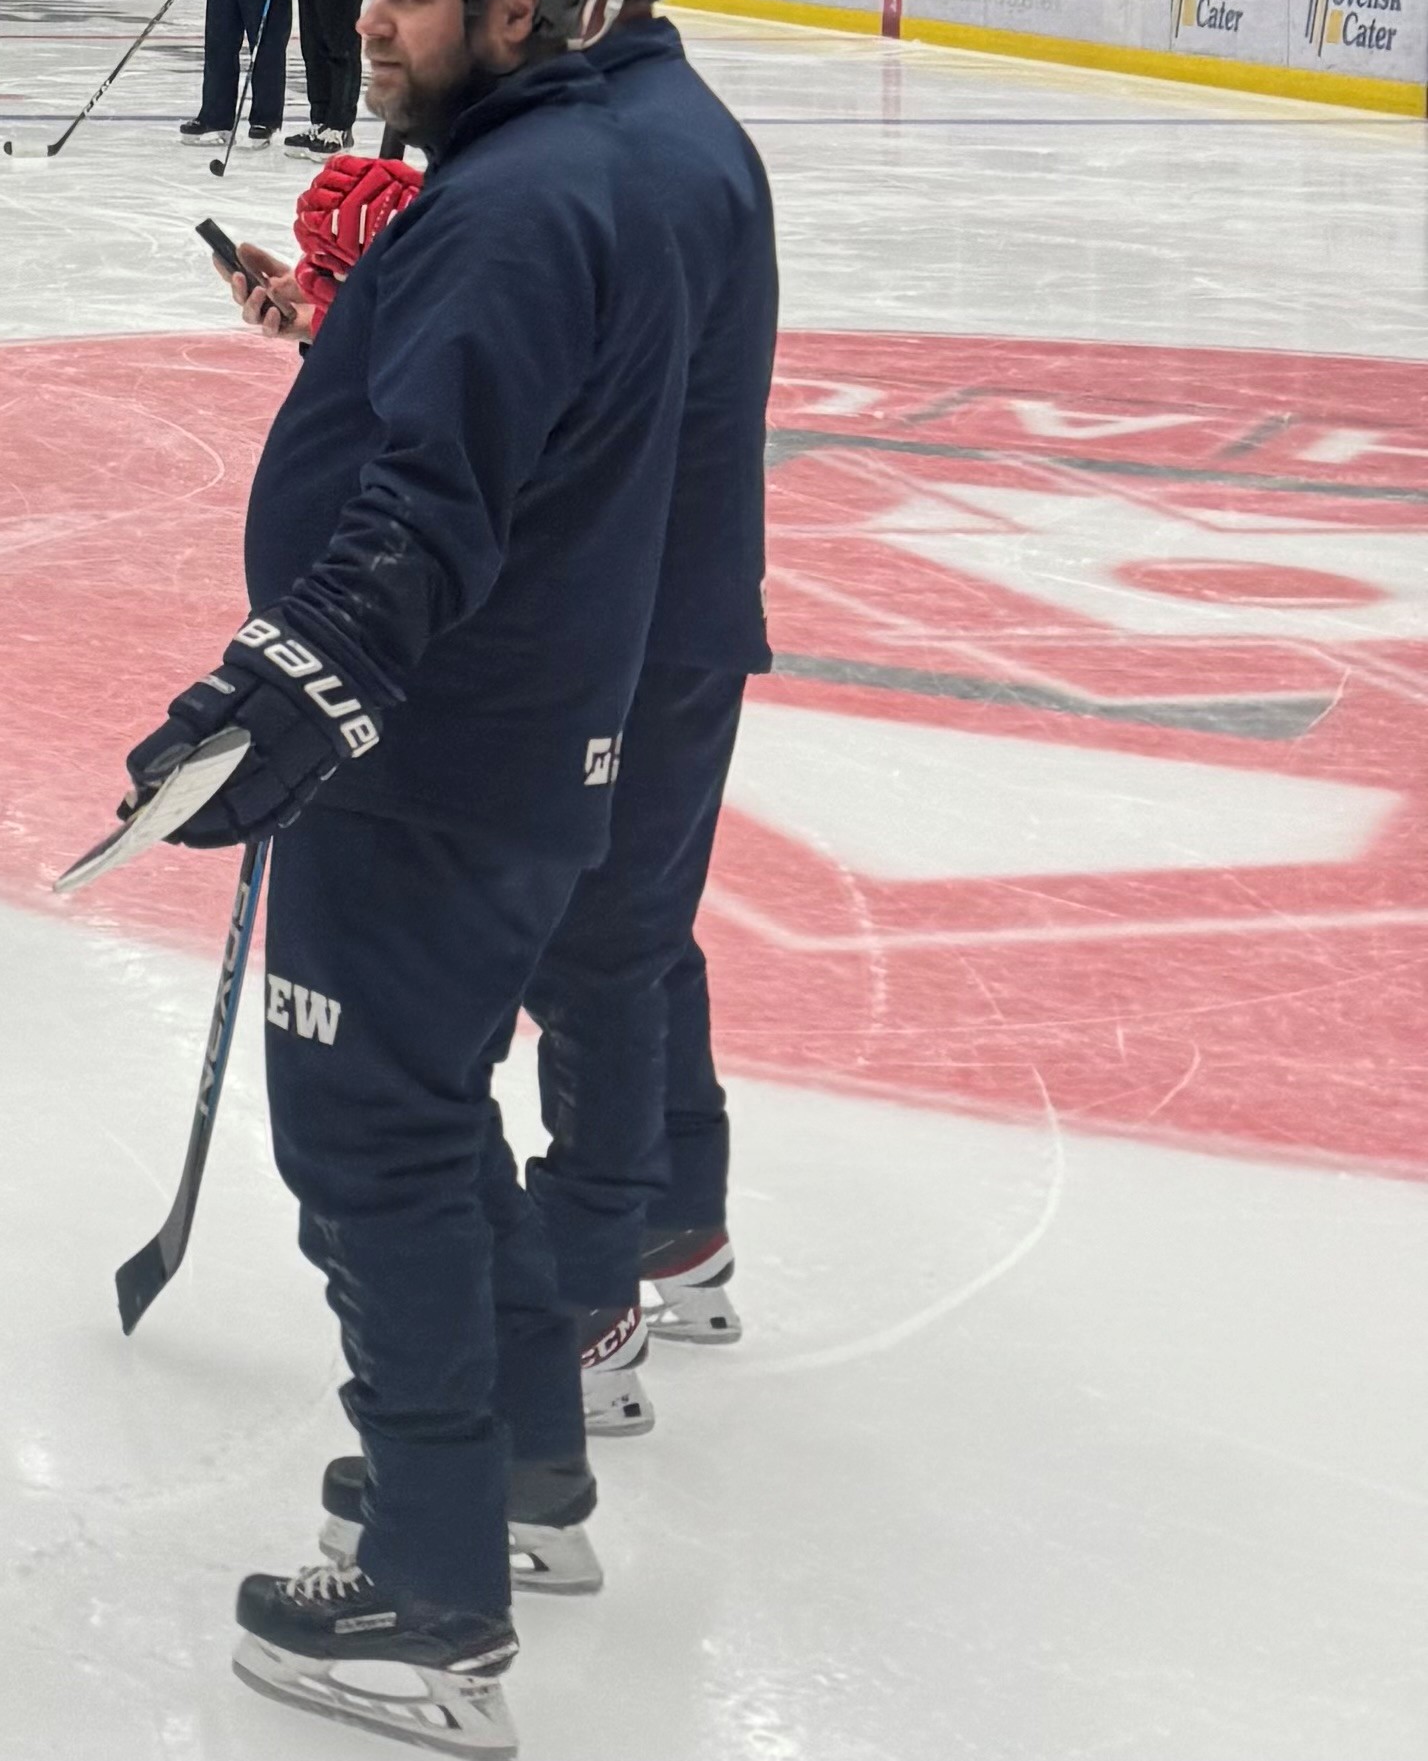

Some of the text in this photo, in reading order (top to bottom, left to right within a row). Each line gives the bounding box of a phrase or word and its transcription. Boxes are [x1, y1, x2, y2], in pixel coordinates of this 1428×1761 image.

[1341, 11, 1397, 53] Cater
[234, 618, 381, 759] BAUE
[266, 973, 342, 1046] EW
